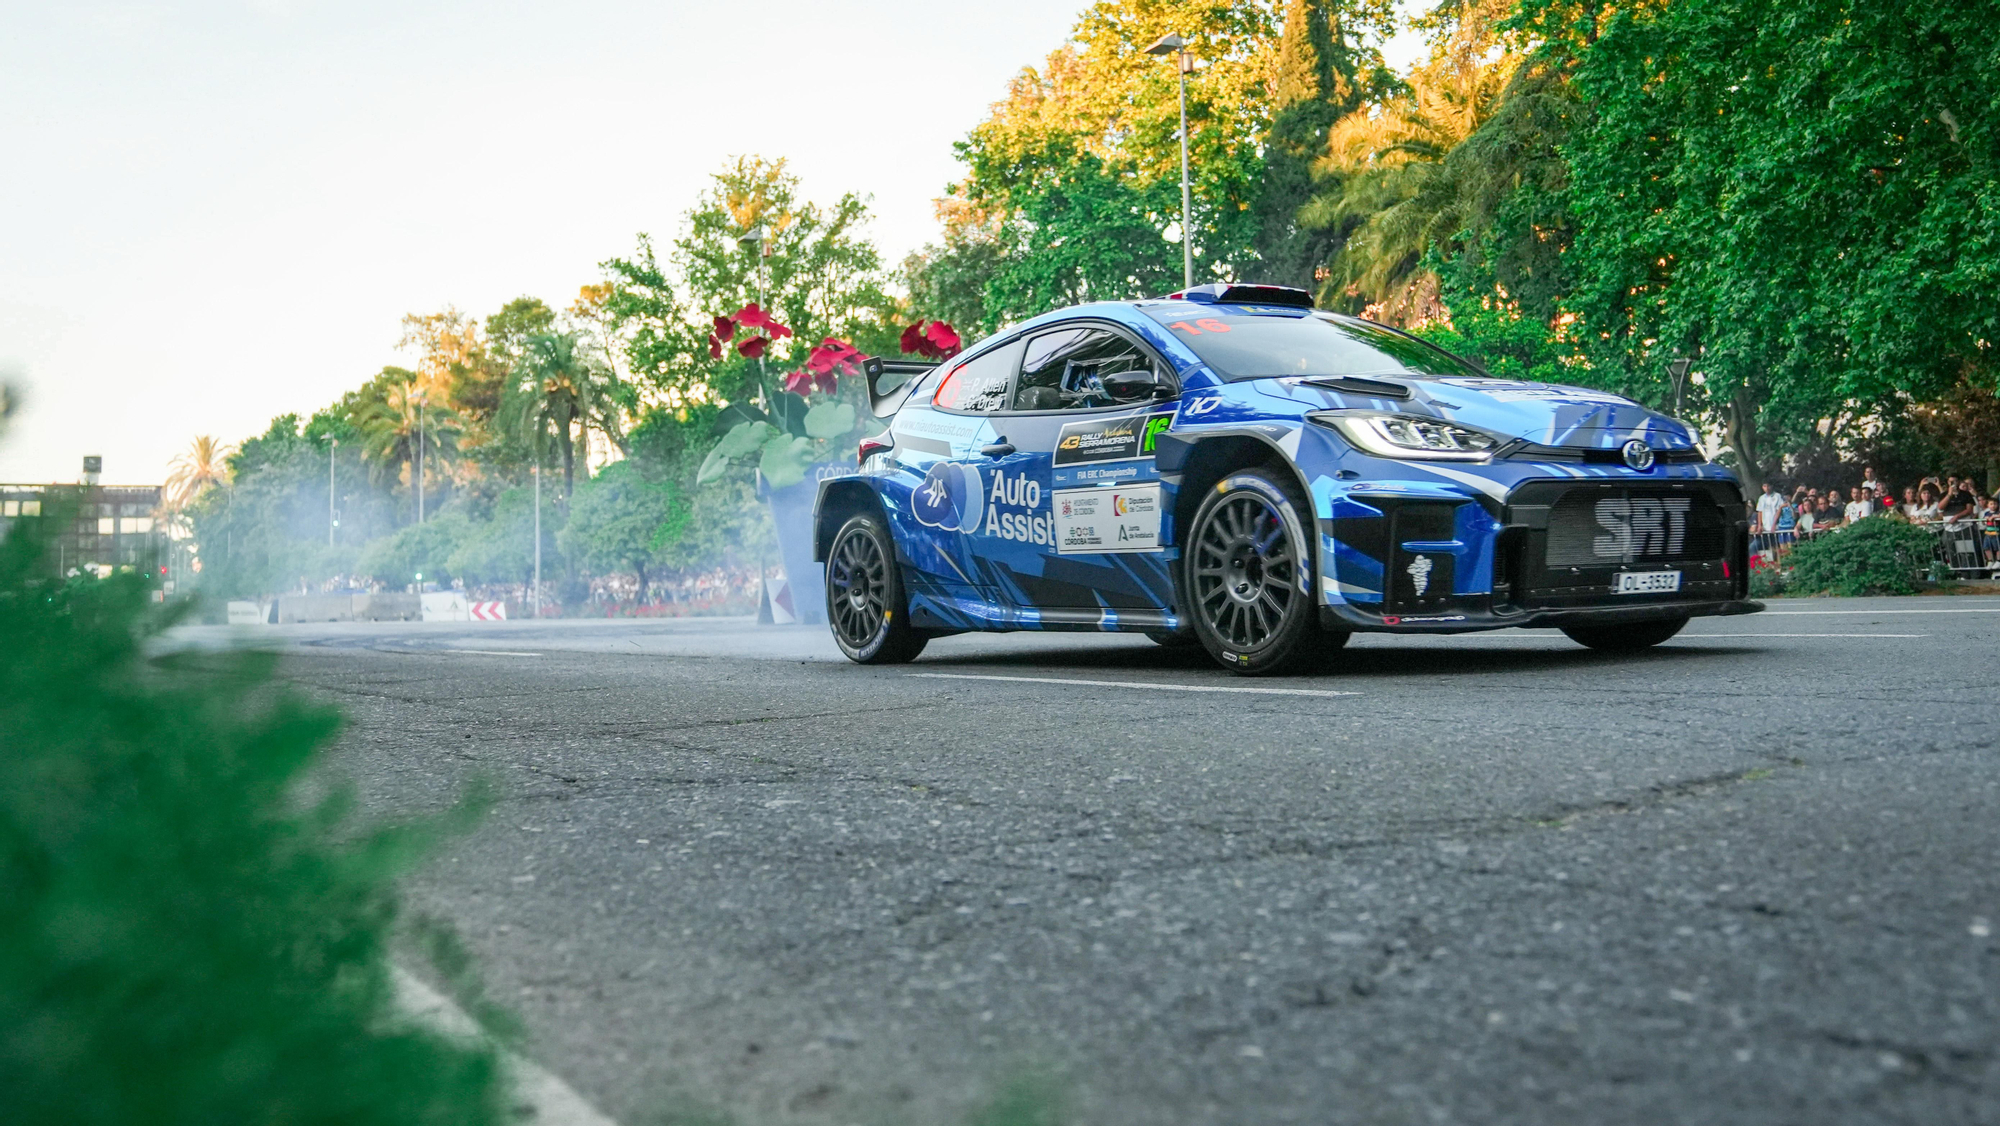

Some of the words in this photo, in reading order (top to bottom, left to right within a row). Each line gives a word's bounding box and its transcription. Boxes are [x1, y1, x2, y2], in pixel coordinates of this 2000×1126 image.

[1170, 318, 1232, 336] 16
[898, 419, 974, 439] www.niautoassist.com
[1081, 432, 1103, 440] RALLY
[1060, 436, 1080, 449] 43
[1077, 471, 1087, 479] FIA
[1088, 470, 1098, 478] ERC
[1099, 467, 1137, 478] Championship
[988, 469, 1041, 509] Auto
[985, 503, 1056, 548] Assist
[1592, 496, 1692, 558] SRT
[1624, 574, 1675, 591] OL-3532
